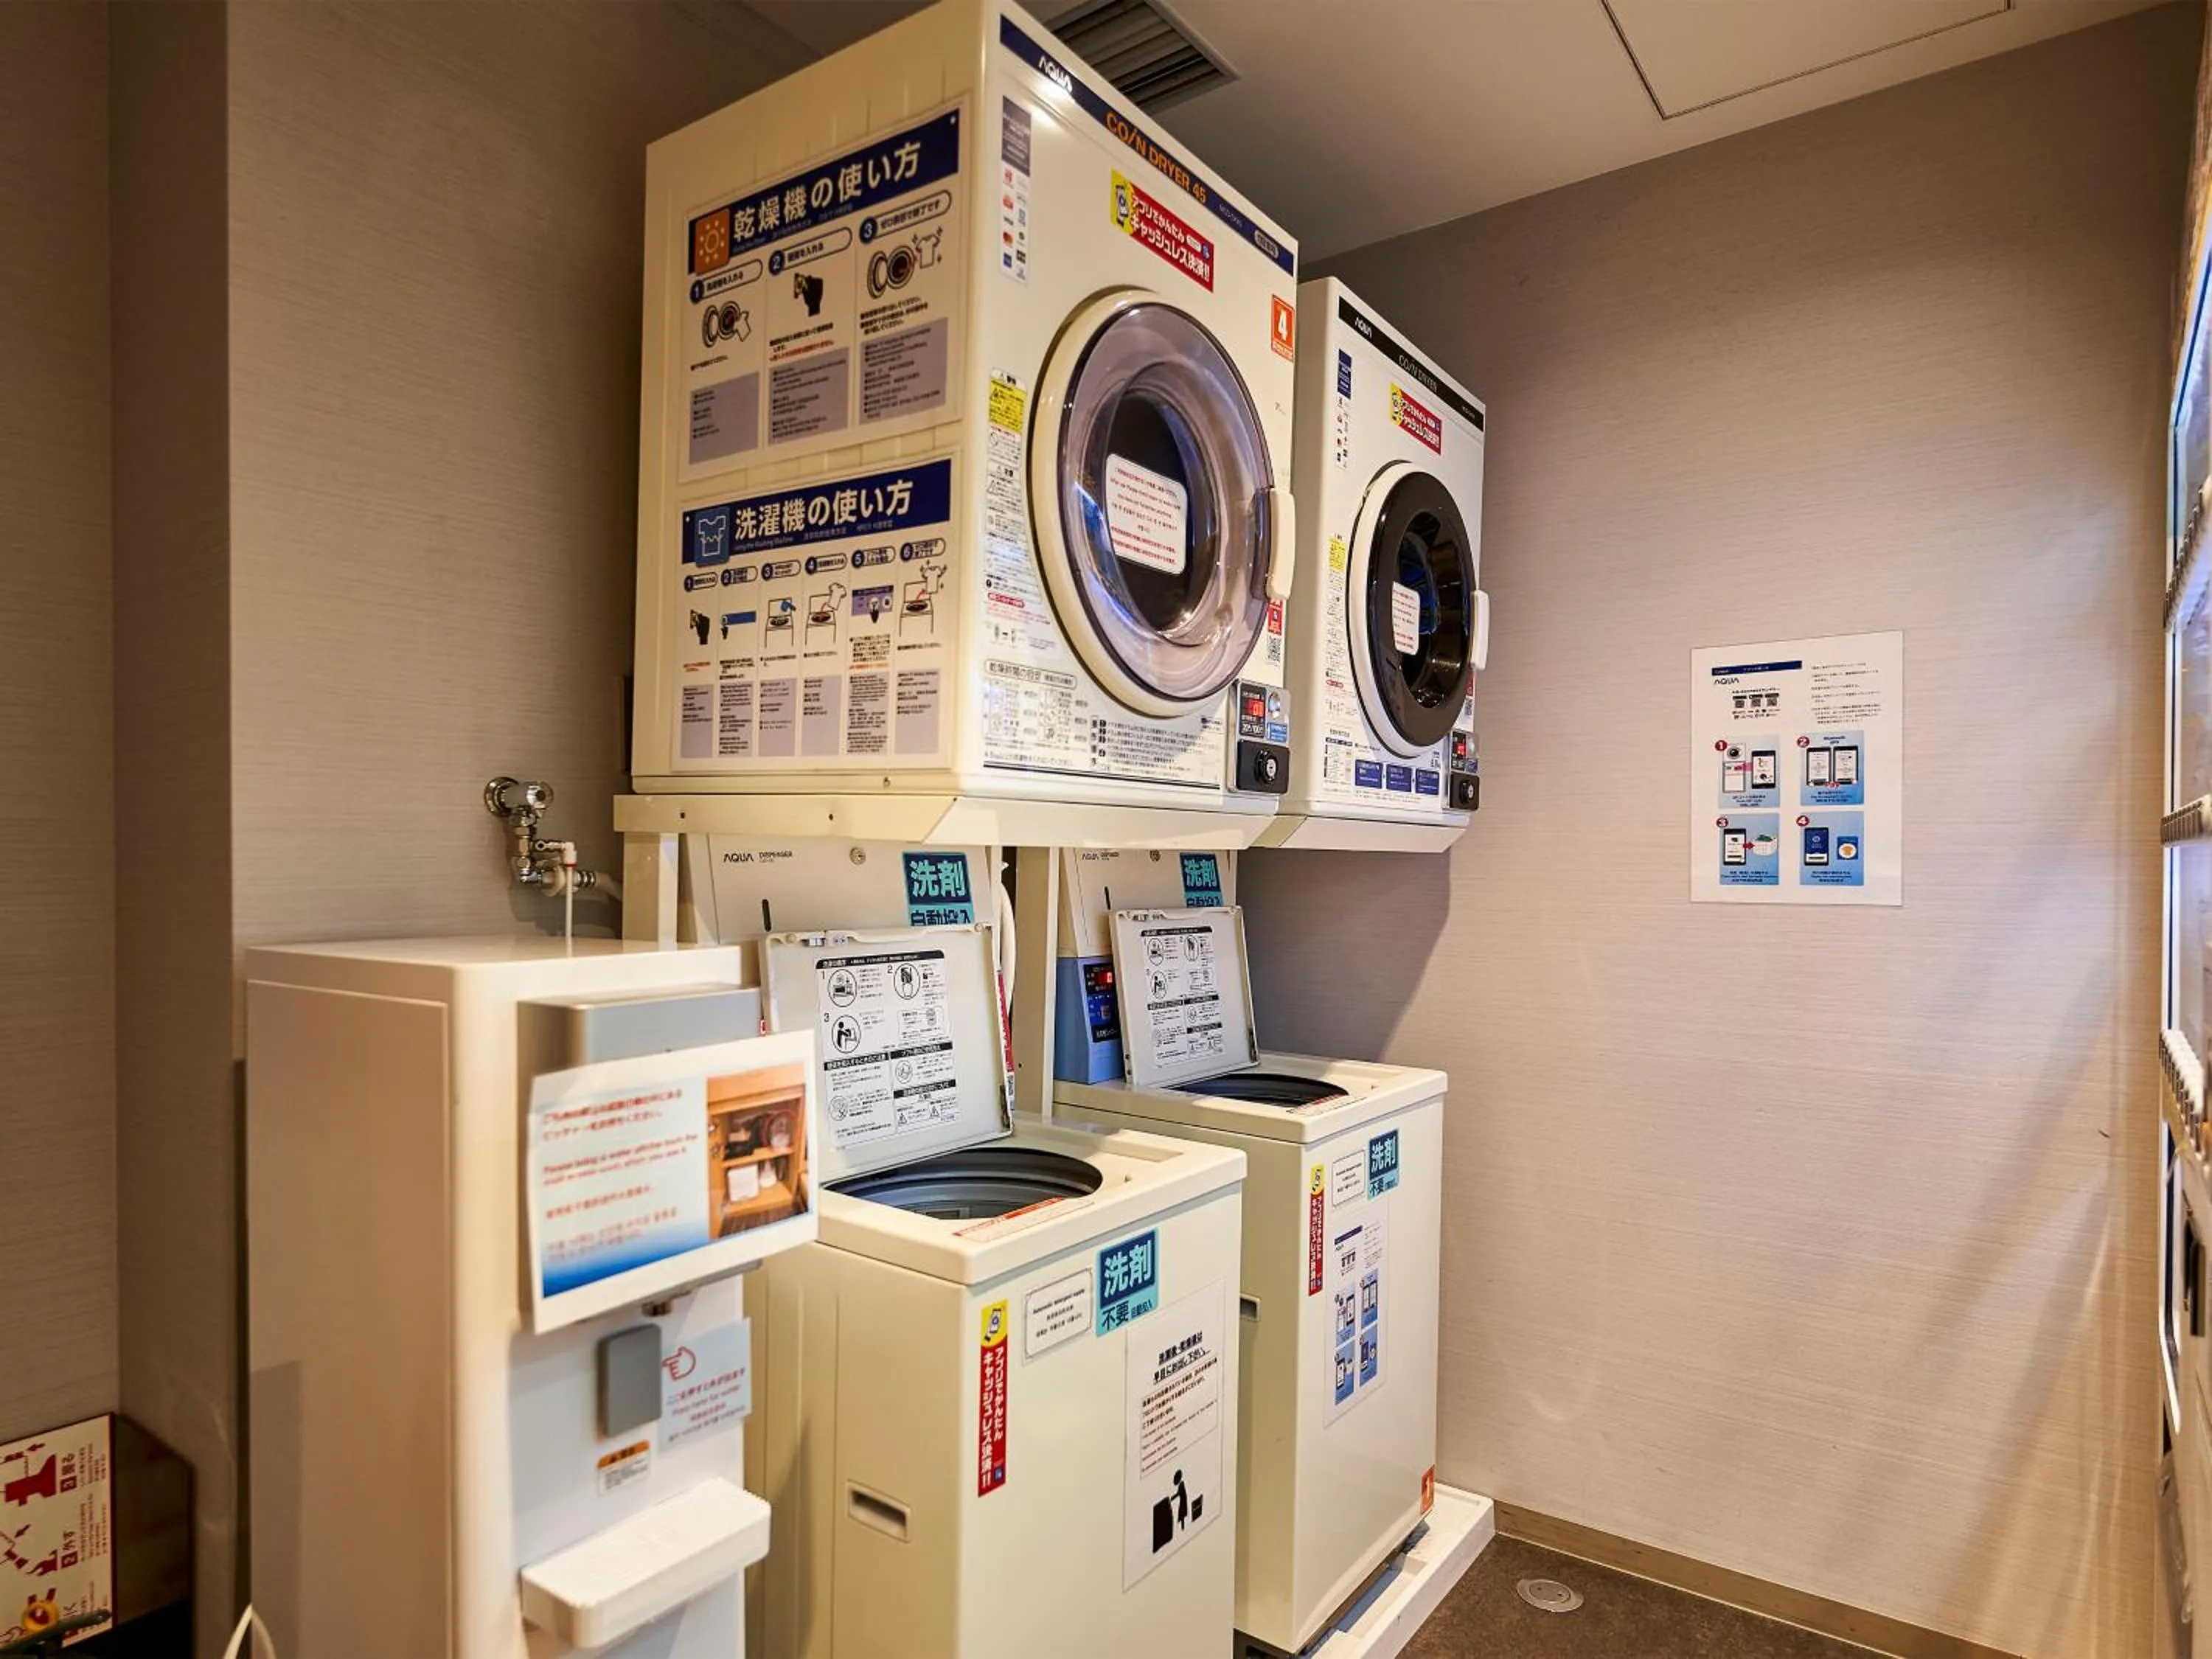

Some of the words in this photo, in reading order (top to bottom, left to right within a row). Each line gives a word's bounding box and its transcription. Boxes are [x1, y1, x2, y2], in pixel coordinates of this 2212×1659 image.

[1039, 56, 1074, 94] AQUA
[733, 140, 922, 243] 乾燥機の使い方
[1148, 145, 1190, 192] DRYER
[1192, 180, 1208, 204] 45
[864, 225, 873, 240] 3
[1132, 194, 1186, 243] アプリでかんたん
[773, 256, 781, 270] 2
[1278, 308, 1288, 341] 4
[1354, 316, 1372, 338] AQUA
[735, 479, 914, 540] 洗濯機の使い方
[723, 853, 754, 862] AQUA
[1184, 859, 1217, 887] 洗剤
[909, 859, 966, 897] 洗剤
[887, 965, 894, 975] 2
[824, 1012, 830, 1023] 3
[1371, 1135, 1396, 1173] 洗剤
[1104, 1239, 1152, 1298] 洗剤
[1102, 1300, 1129, 1331] 不要
[995, 1346, 1004, 1441] アプリでかんたん
